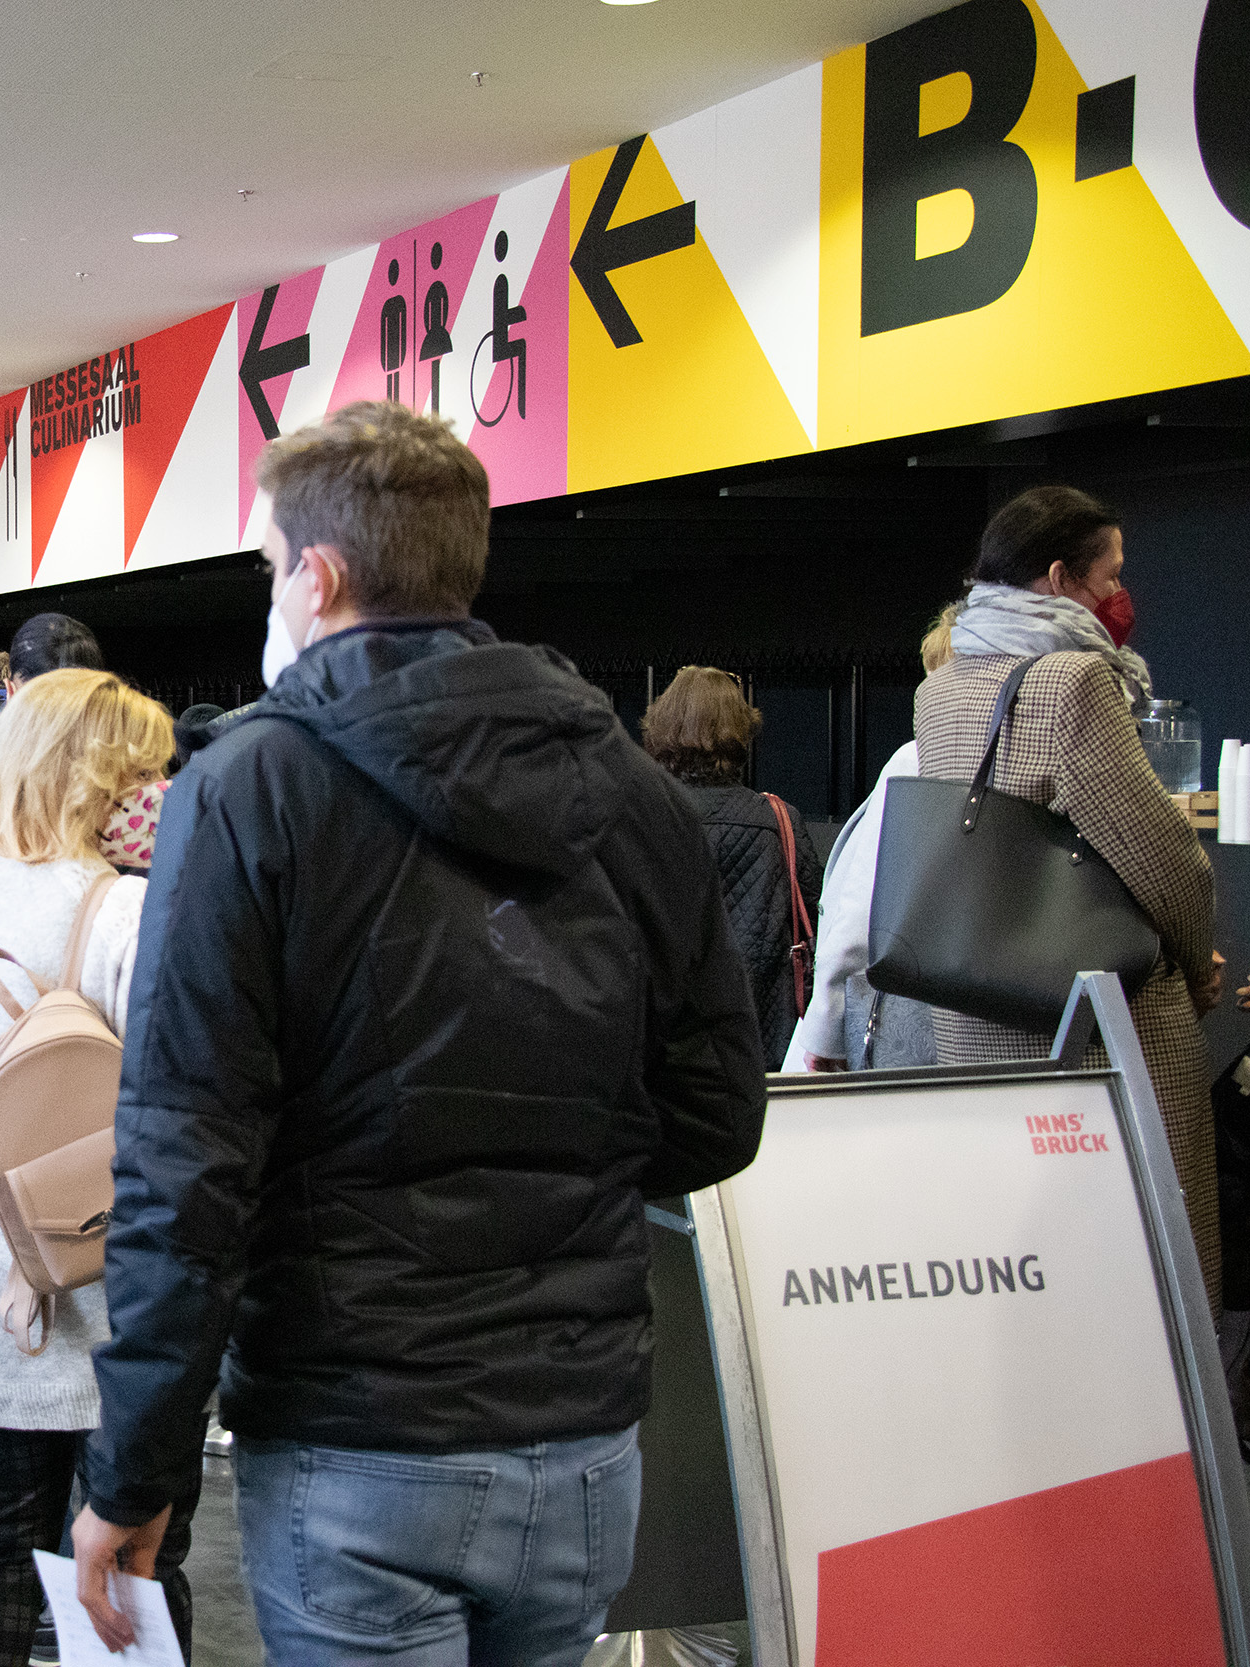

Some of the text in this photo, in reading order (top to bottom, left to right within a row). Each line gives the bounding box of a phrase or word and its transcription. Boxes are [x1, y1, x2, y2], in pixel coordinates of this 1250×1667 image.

[30, 342, 140, 420] MESSESAAL
[31, 384, 141, 458] CULINARIUM
[1030, 1133, 1109, 1155] BRUCK
[783, 1254, 1046, 1307] ANMELDUNG
